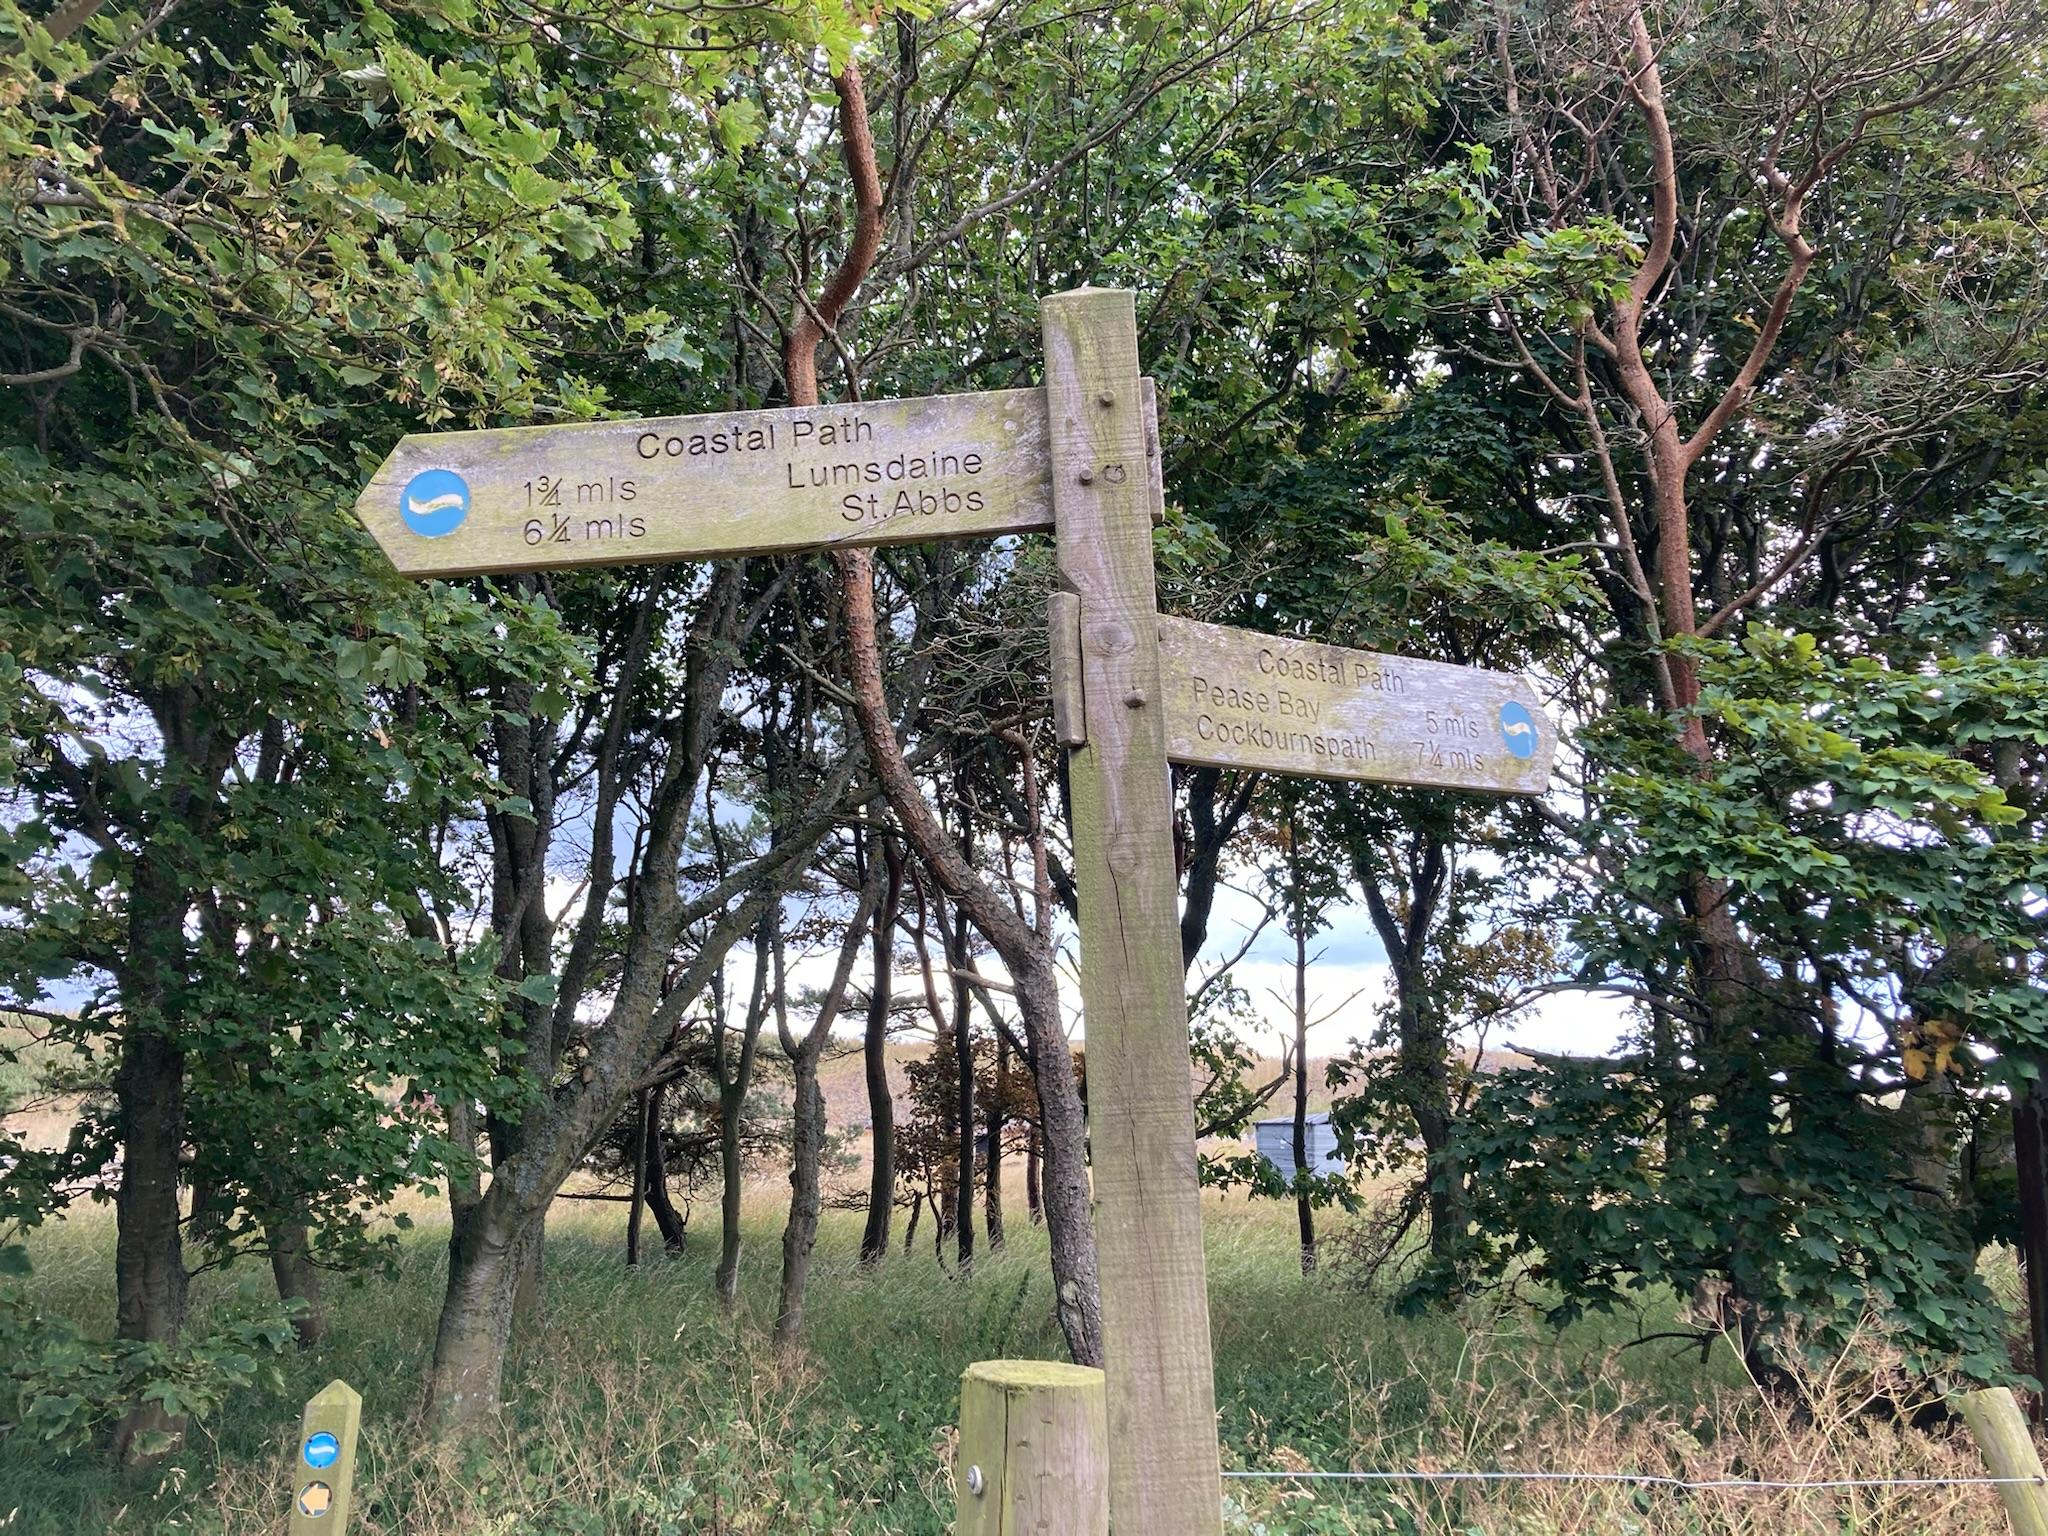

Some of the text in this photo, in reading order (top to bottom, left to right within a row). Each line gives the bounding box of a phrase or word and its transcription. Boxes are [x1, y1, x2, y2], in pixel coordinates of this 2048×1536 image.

[636, 415, 873, 460] Coastal Path
[577, 476, 638, 504] mls
[787, 450, 983, 489] Lumsdaine
[585, 513, 646, 541] mls
[840, 487, 984, 522] St.Abbs
[1258, 648, 1405, 694] Coastal Path
[1192, 676, 1480, 739] Pease Bay 5 mls
[1197, 713, 1377, 762] Cockburnspath
[1450, 747, 1485, 772] mls
